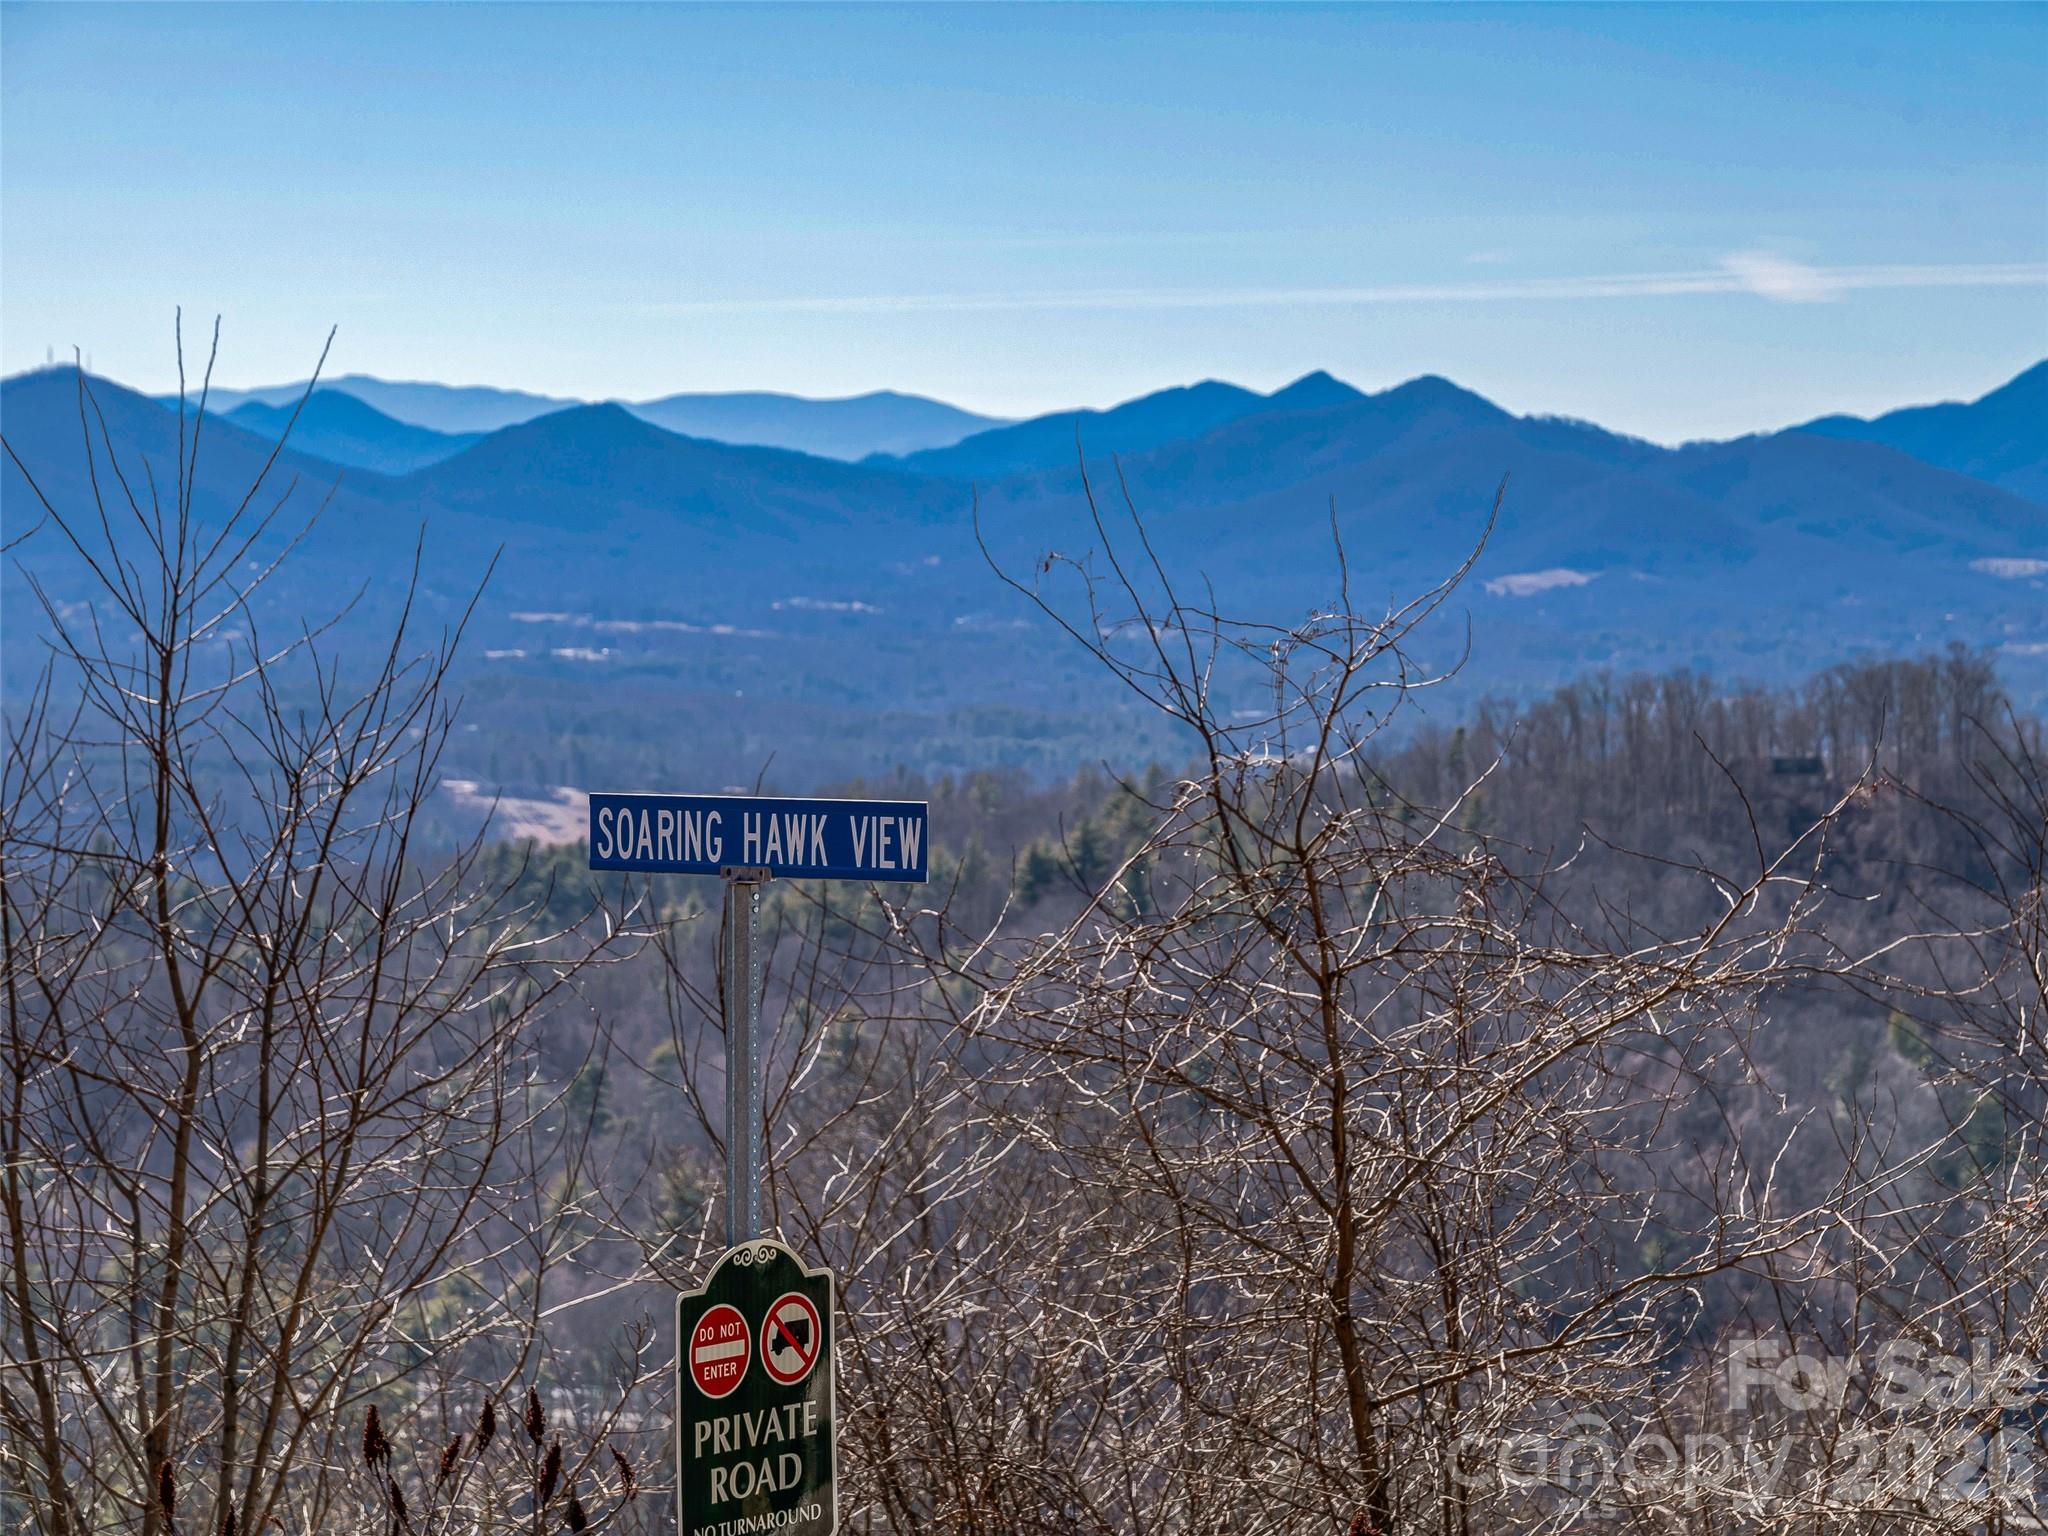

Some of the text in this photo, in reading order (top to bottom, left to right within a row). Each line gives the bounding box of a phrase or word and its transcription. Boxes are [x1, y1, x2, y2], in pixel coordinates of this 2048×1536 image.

[597, 807, 922, 870] SOARING HAWK VIEW
[700, 1321, 741, 1342] DO NOT
[704, 1361, 737, 1381] ENTER
[694, 1400, 817, 1459] PRIVATE
[710, 1453, 803, 1504] ROAD
[718, 1503, 822, 1536] TURNAROUND
